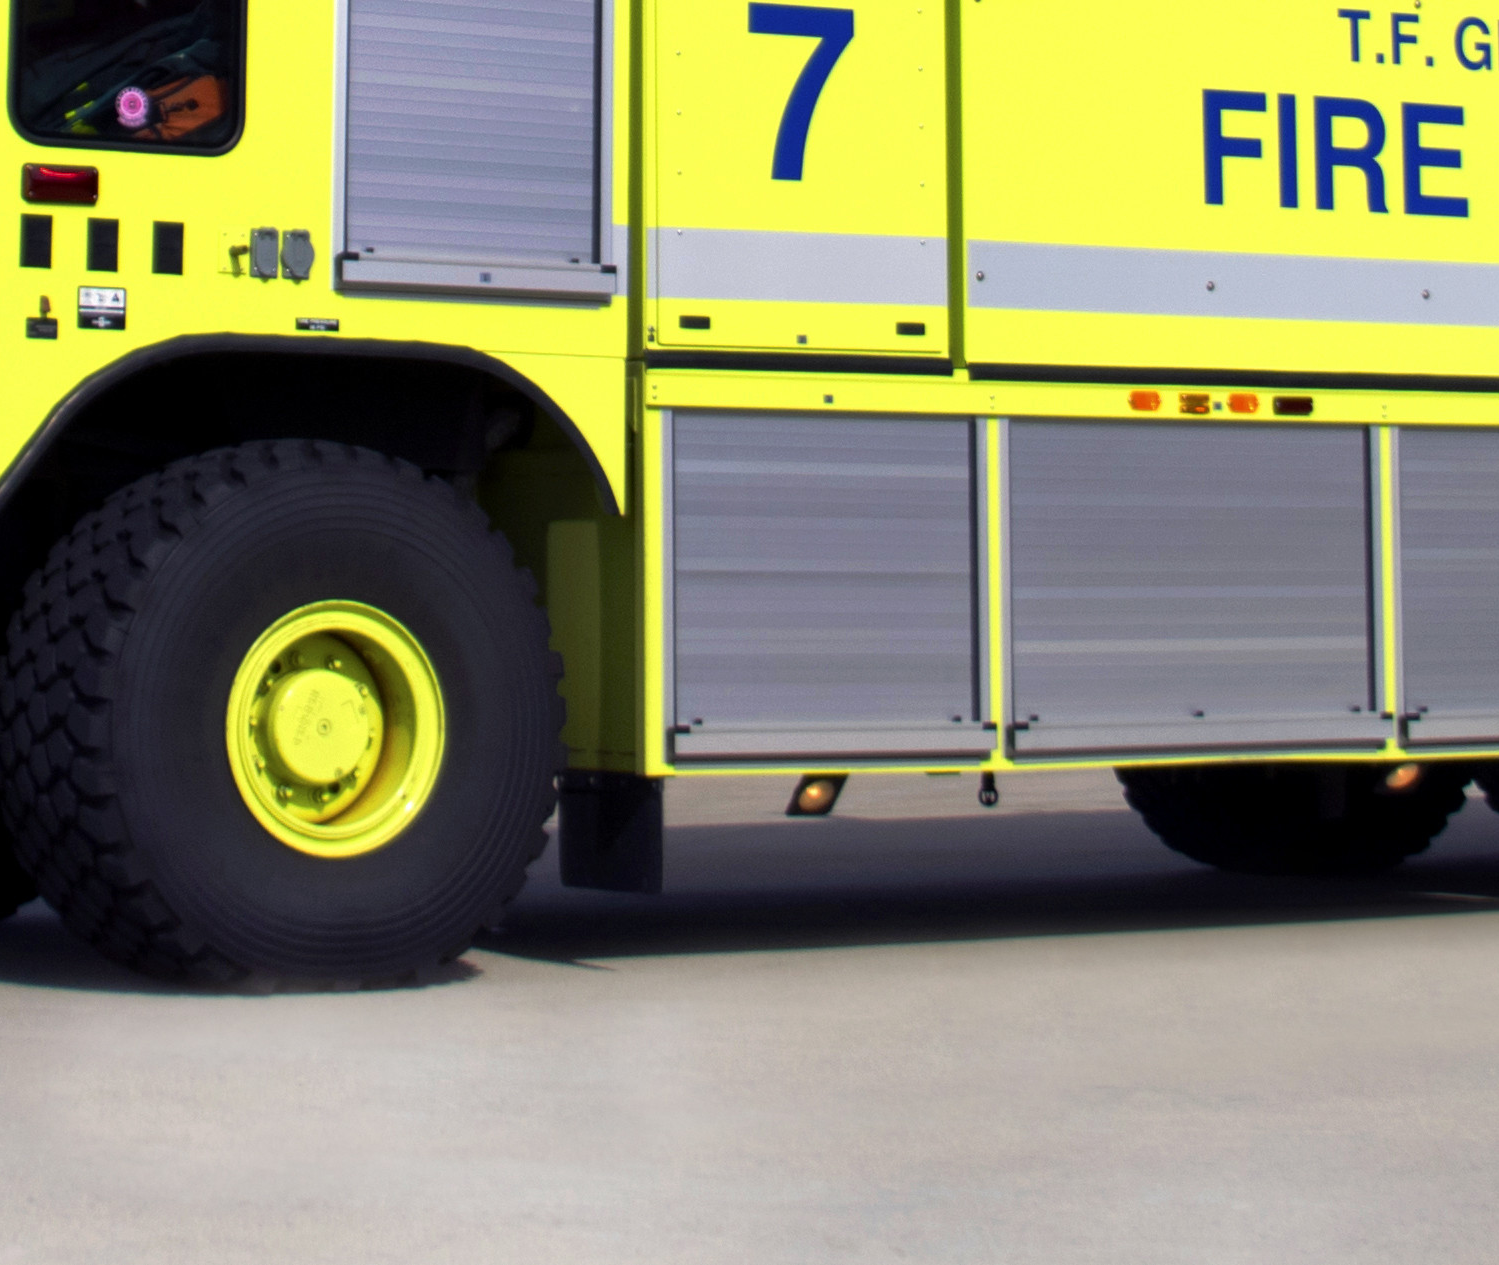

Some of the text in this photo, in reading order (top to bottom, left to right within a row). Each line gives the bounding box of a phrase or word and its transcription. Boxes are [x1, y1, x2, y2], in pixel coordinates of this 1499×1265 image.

[748, 2, 855, 181] 7
[1338, 8, 1435, 68] T.F.
[1201, 88, 1470, 218] FIRE
